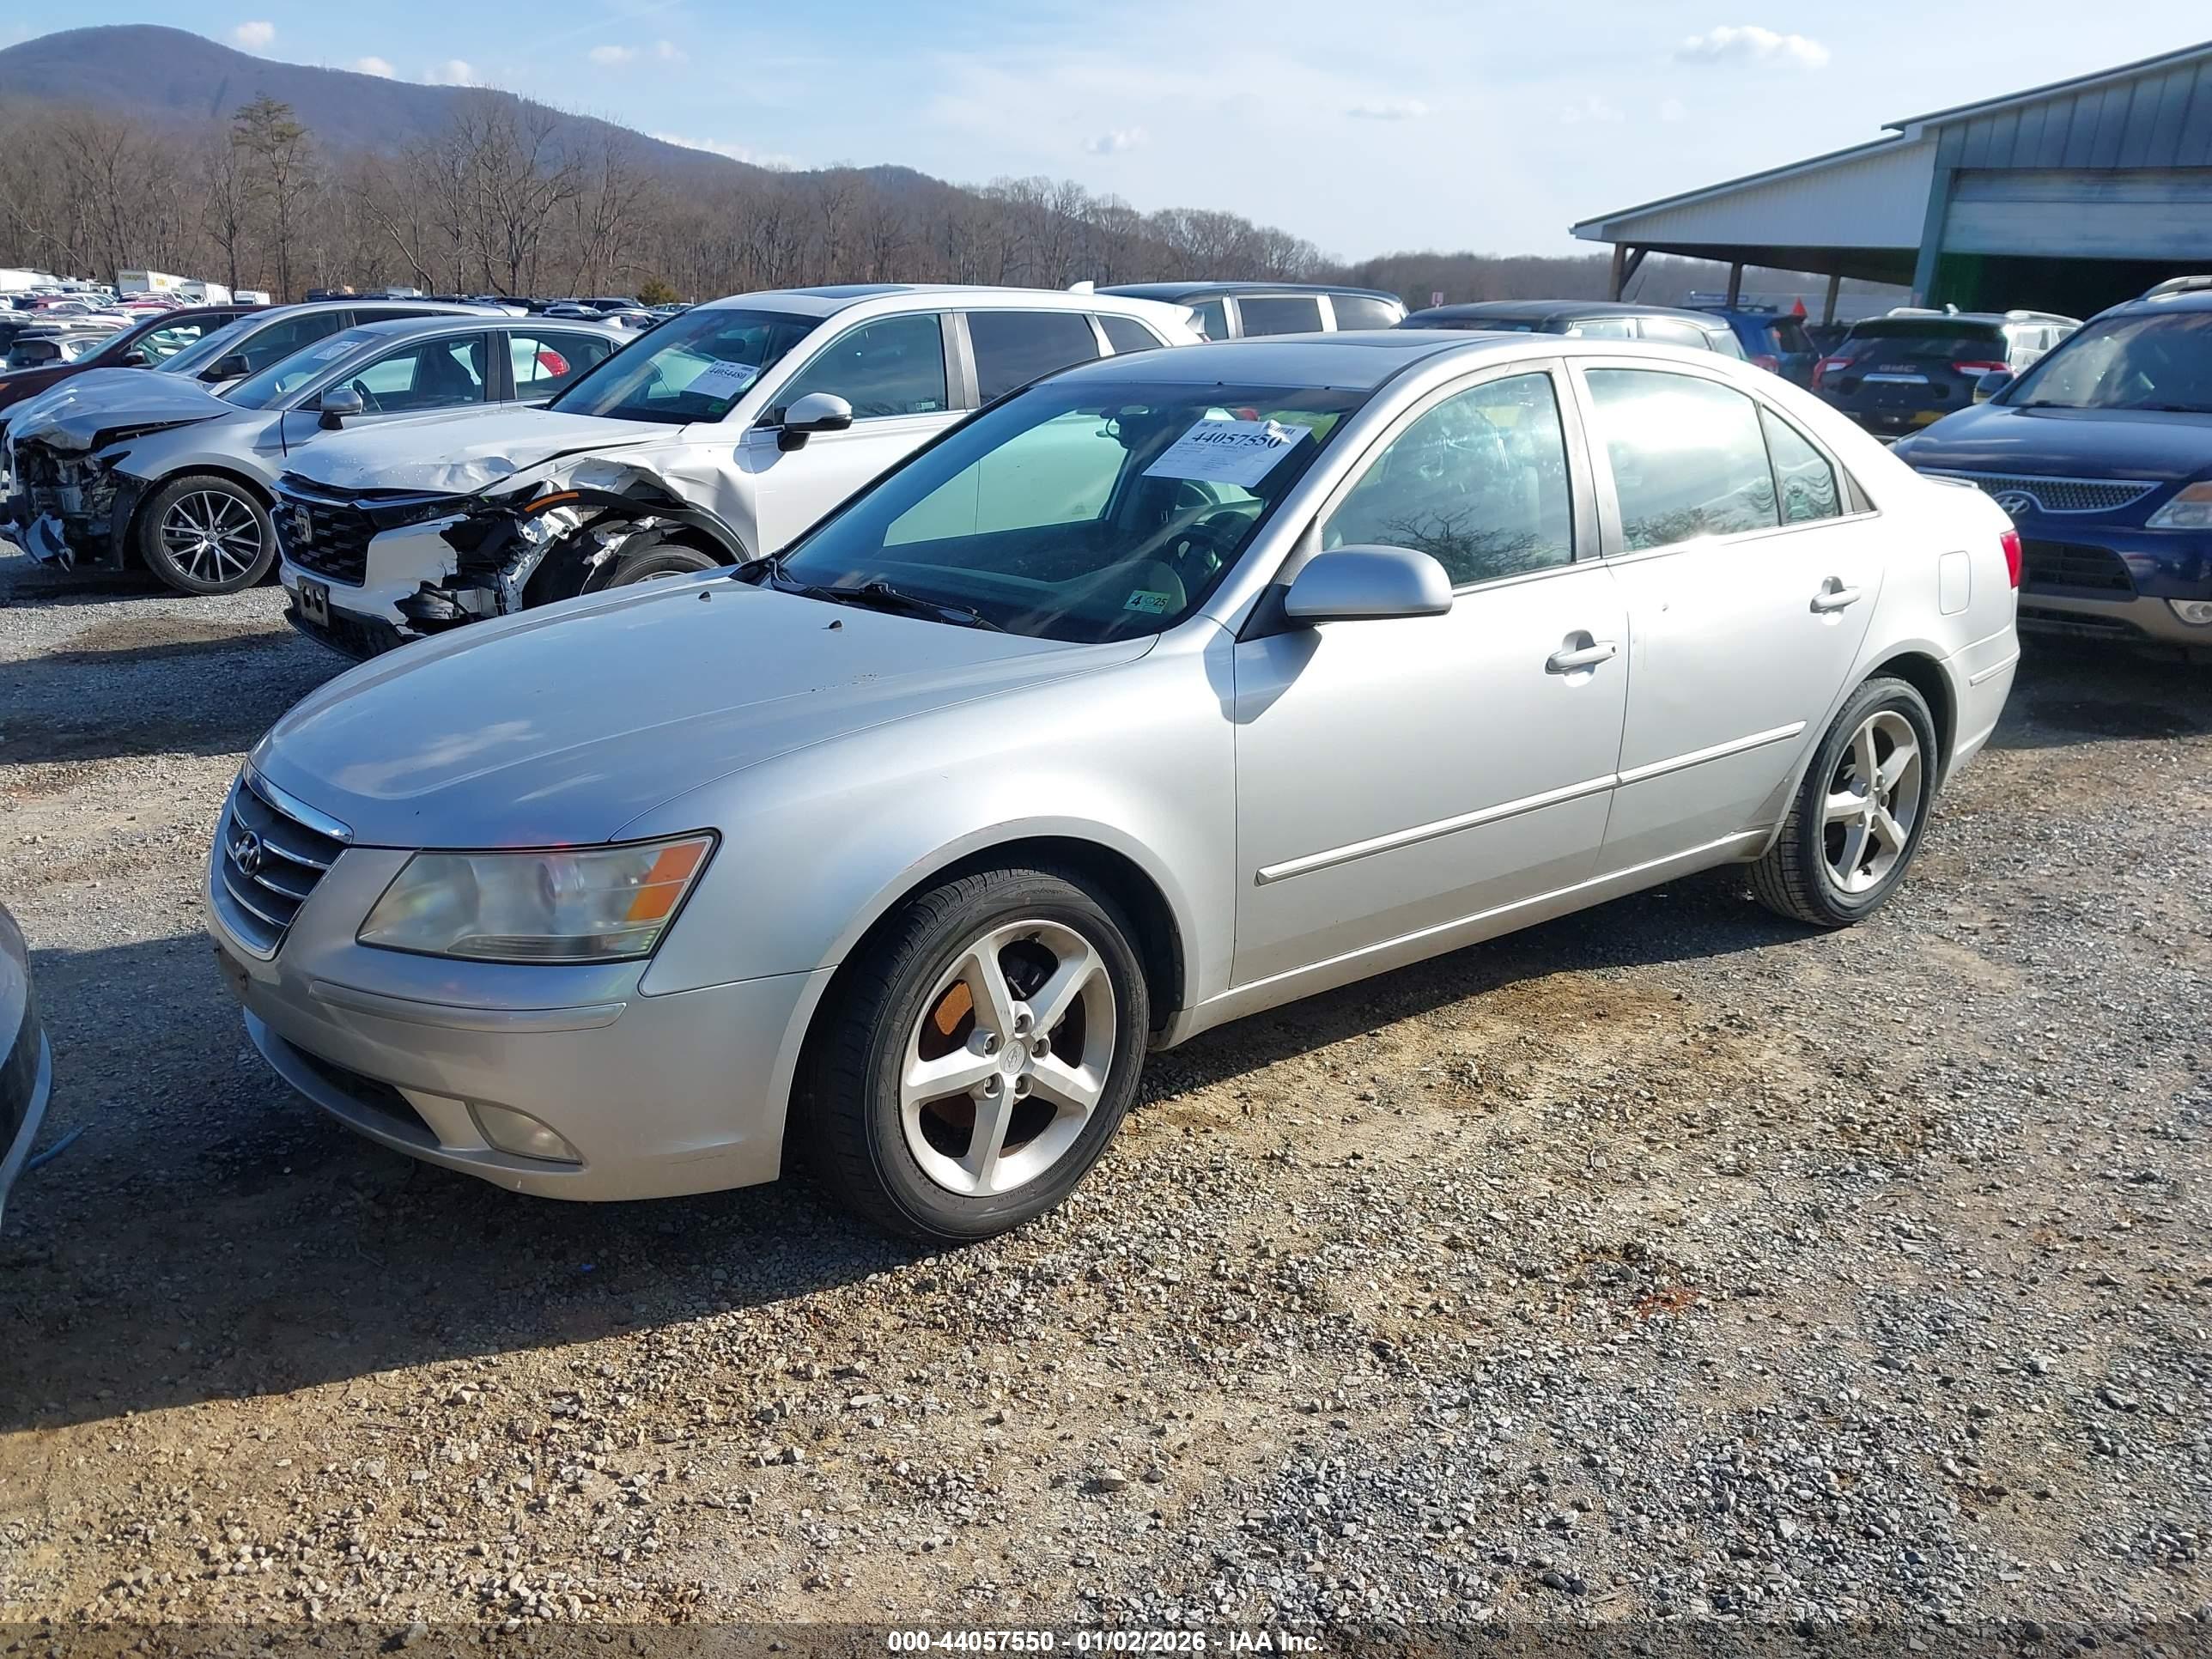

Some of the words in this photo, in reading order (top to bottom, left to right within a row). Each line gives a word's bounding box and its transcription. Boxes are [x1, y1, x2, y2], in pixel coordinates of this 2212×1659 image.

[1878, 363, 1917, 373] GMC
[1192, 431, 1283, 449] 44057550
[1130, 594, 1144, 607] 4
[1153, 597, 1168, 607] 25
